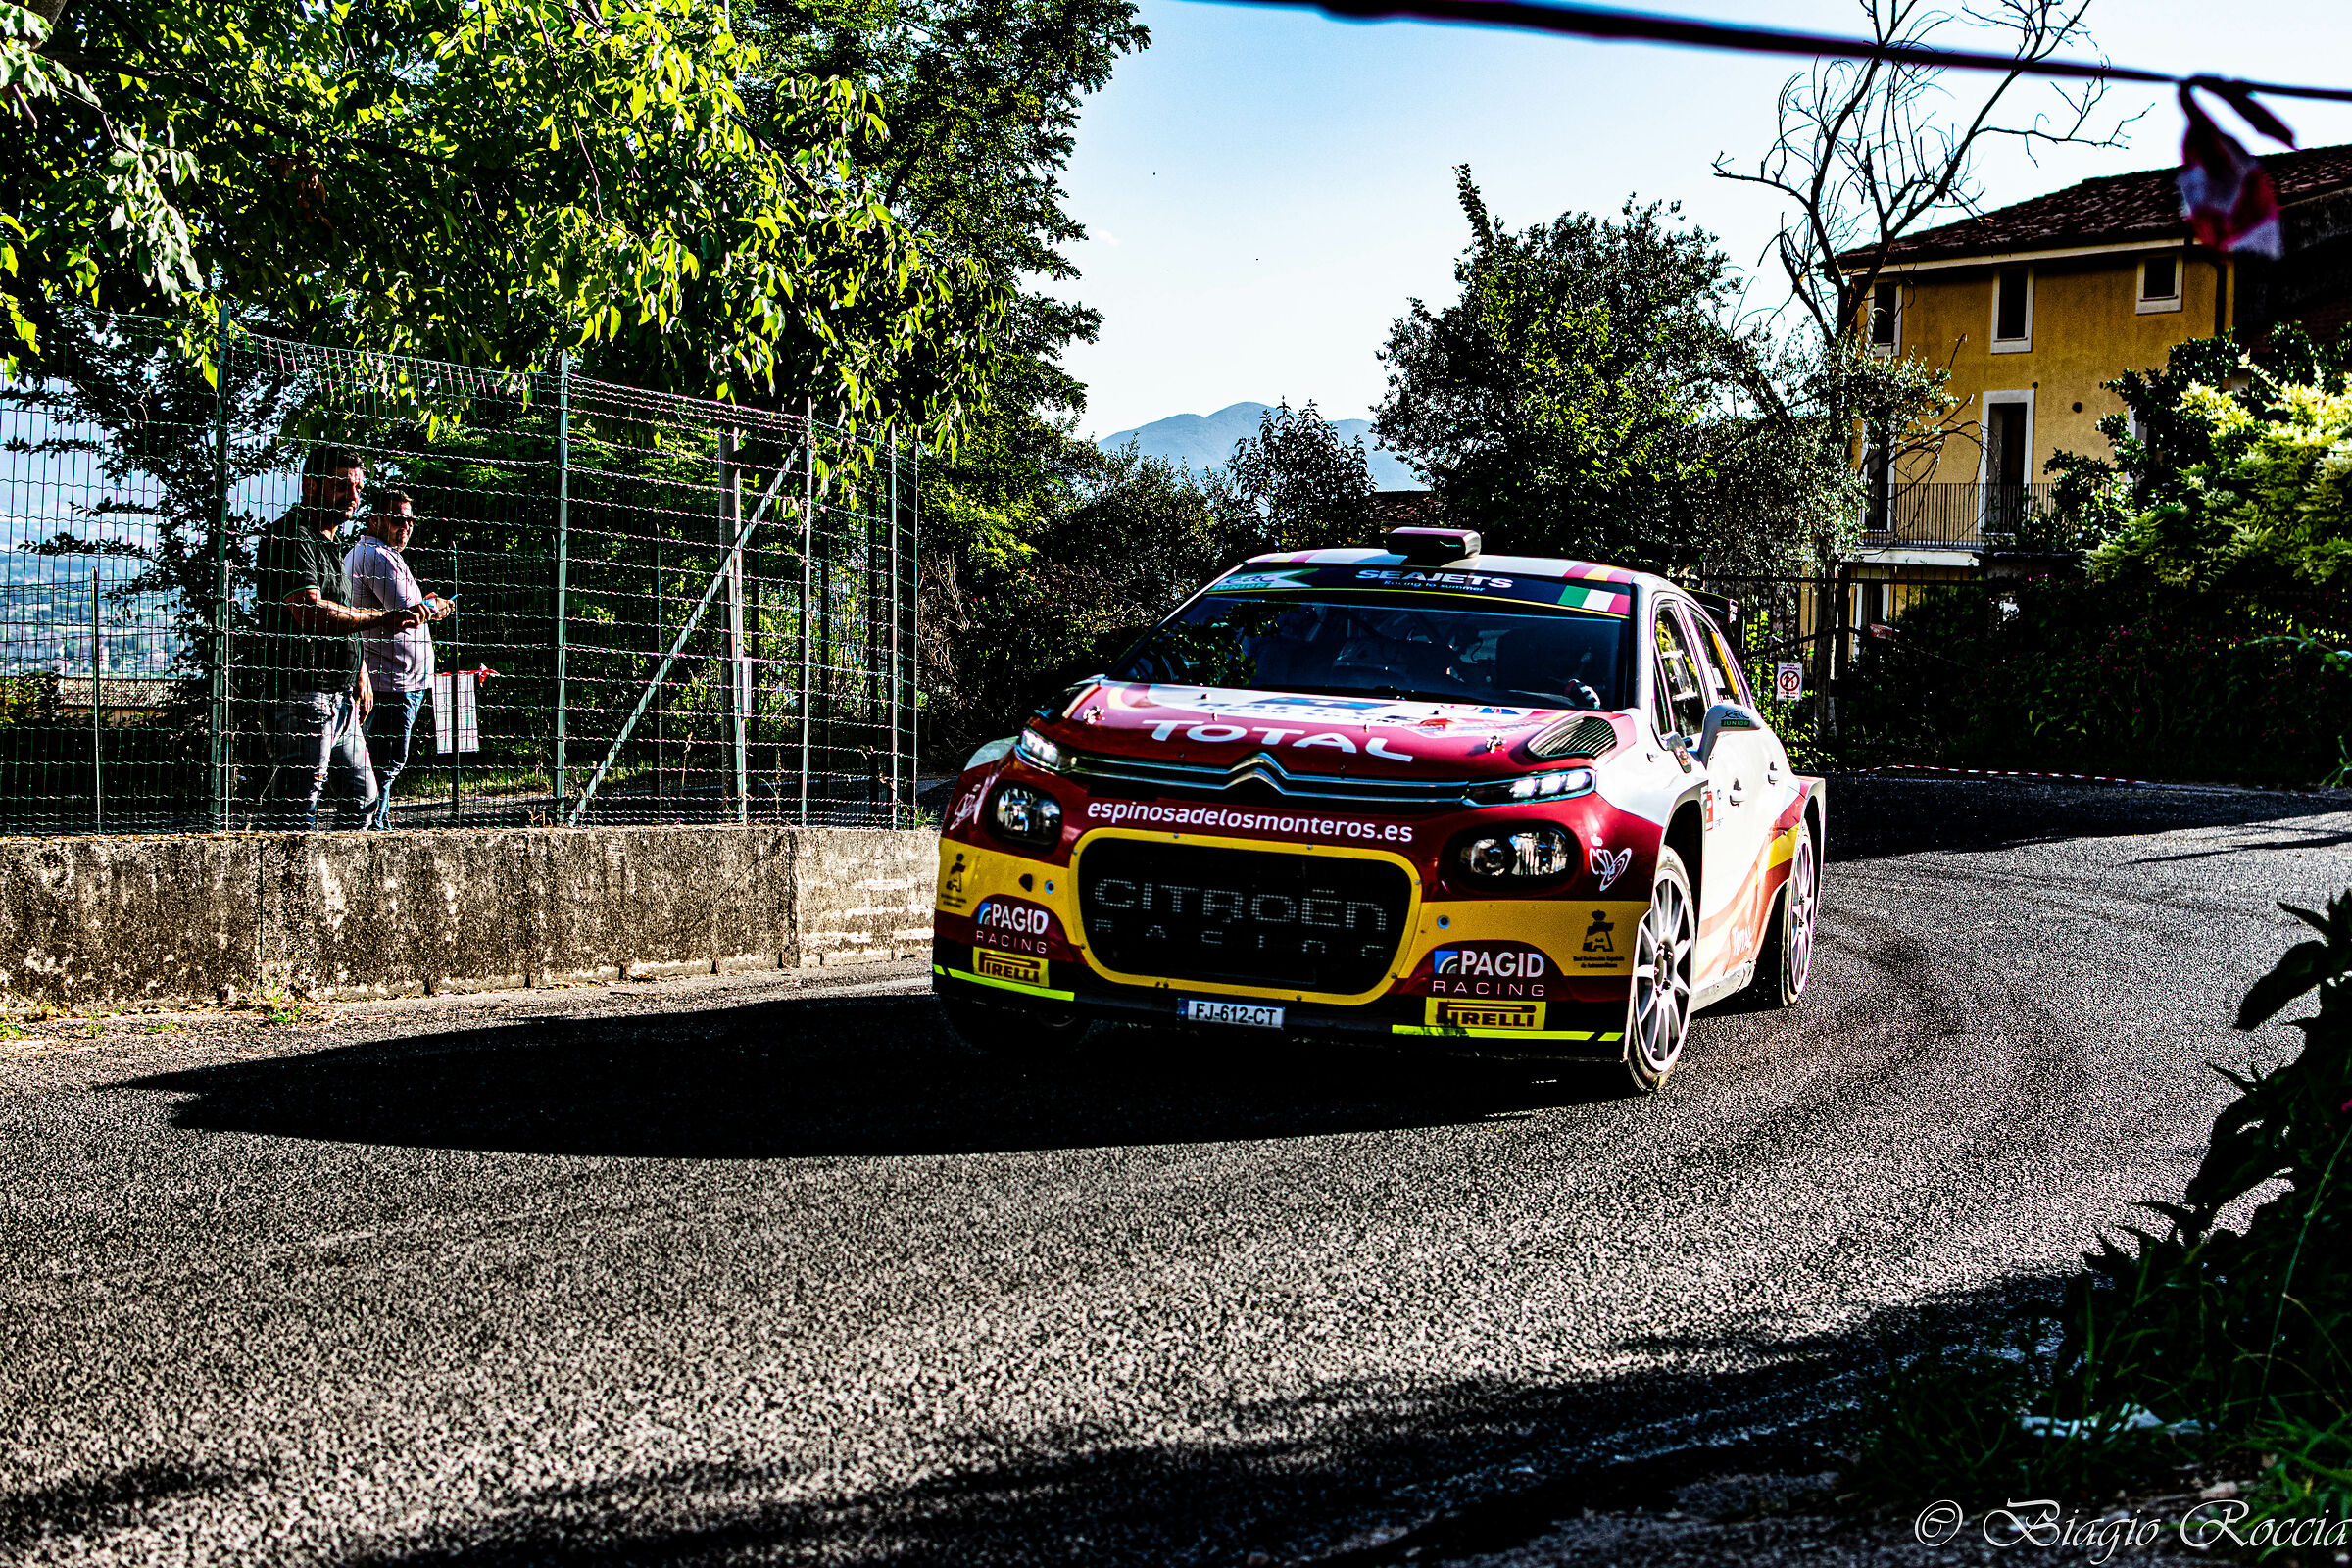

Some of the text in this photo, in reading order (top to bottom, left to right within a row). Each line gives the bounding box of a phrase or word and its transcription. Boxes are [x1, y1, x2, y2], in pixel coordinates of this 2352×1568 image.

[1355, 569, 1514, 589] SEAJETS
[1383, 579, 1422, 588] Racing
[1440, 584, 1487, 593] summer
[1142, 719, 1414, 763] TOTAL
[1087, 801, 1414, 843] espinosadelosmonteros.es
[992, 903, 1049, 935] PAGID
[975, 929, 1048, 955] RACING
[978, 950, 1042, 984] PIRELLI
[1460, 950, 1545, 978] PAGID
[1432, 980, 1545, 997] RACING
[1196, 1003, 1277, 1026] FJ-612-CT
[1436, 1001, 1538, 1028] PIRELLI
